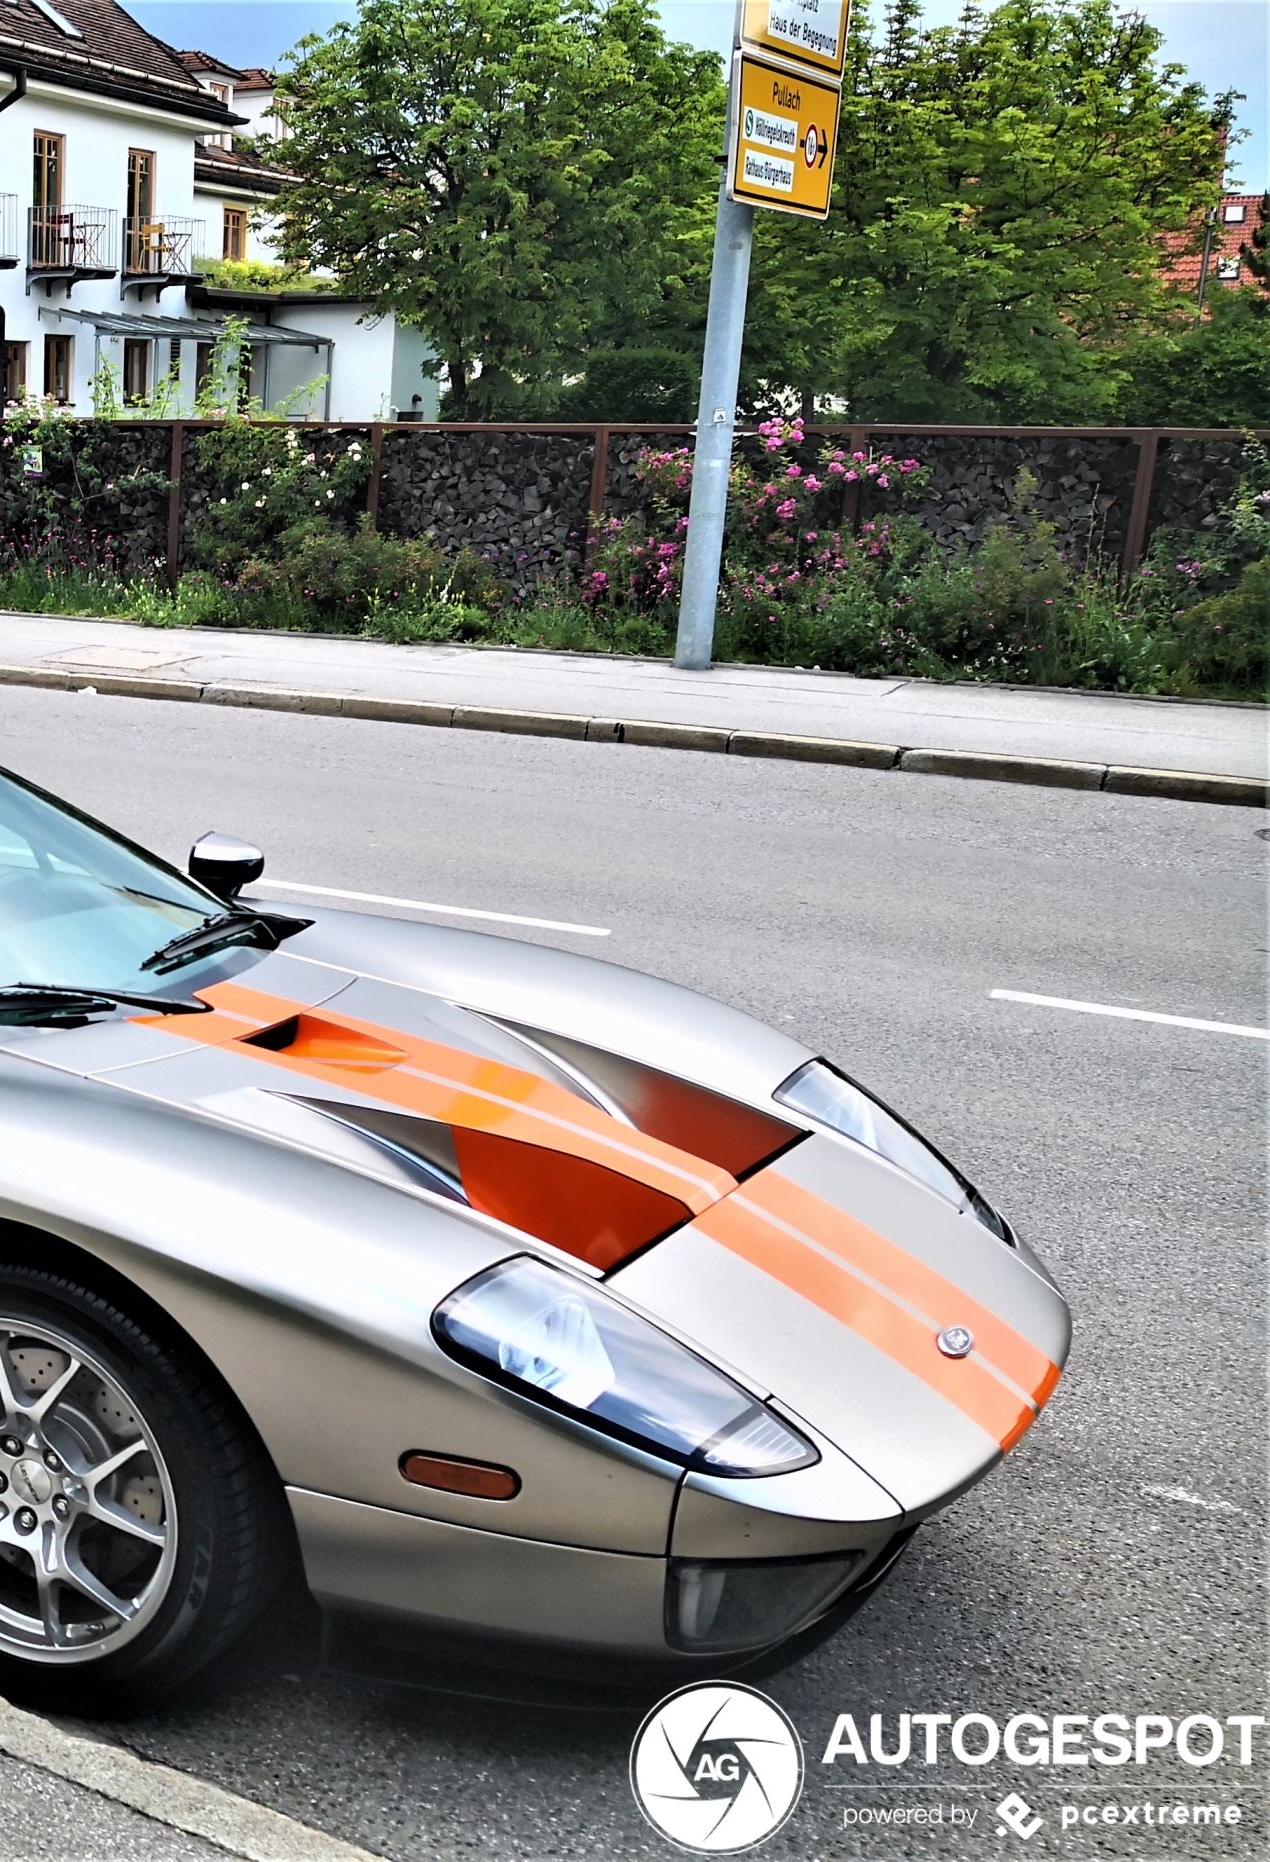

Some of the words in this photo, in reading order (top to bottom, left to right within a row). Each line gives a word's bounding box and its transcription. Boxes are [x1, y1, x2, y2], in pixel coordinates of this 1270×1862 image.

[770, 10, 787, 33] Haus
[789, 18, 801, 38] der
[803, 22, 837, 57] Begegnung
[772, 82, 801, 111] Pullach
